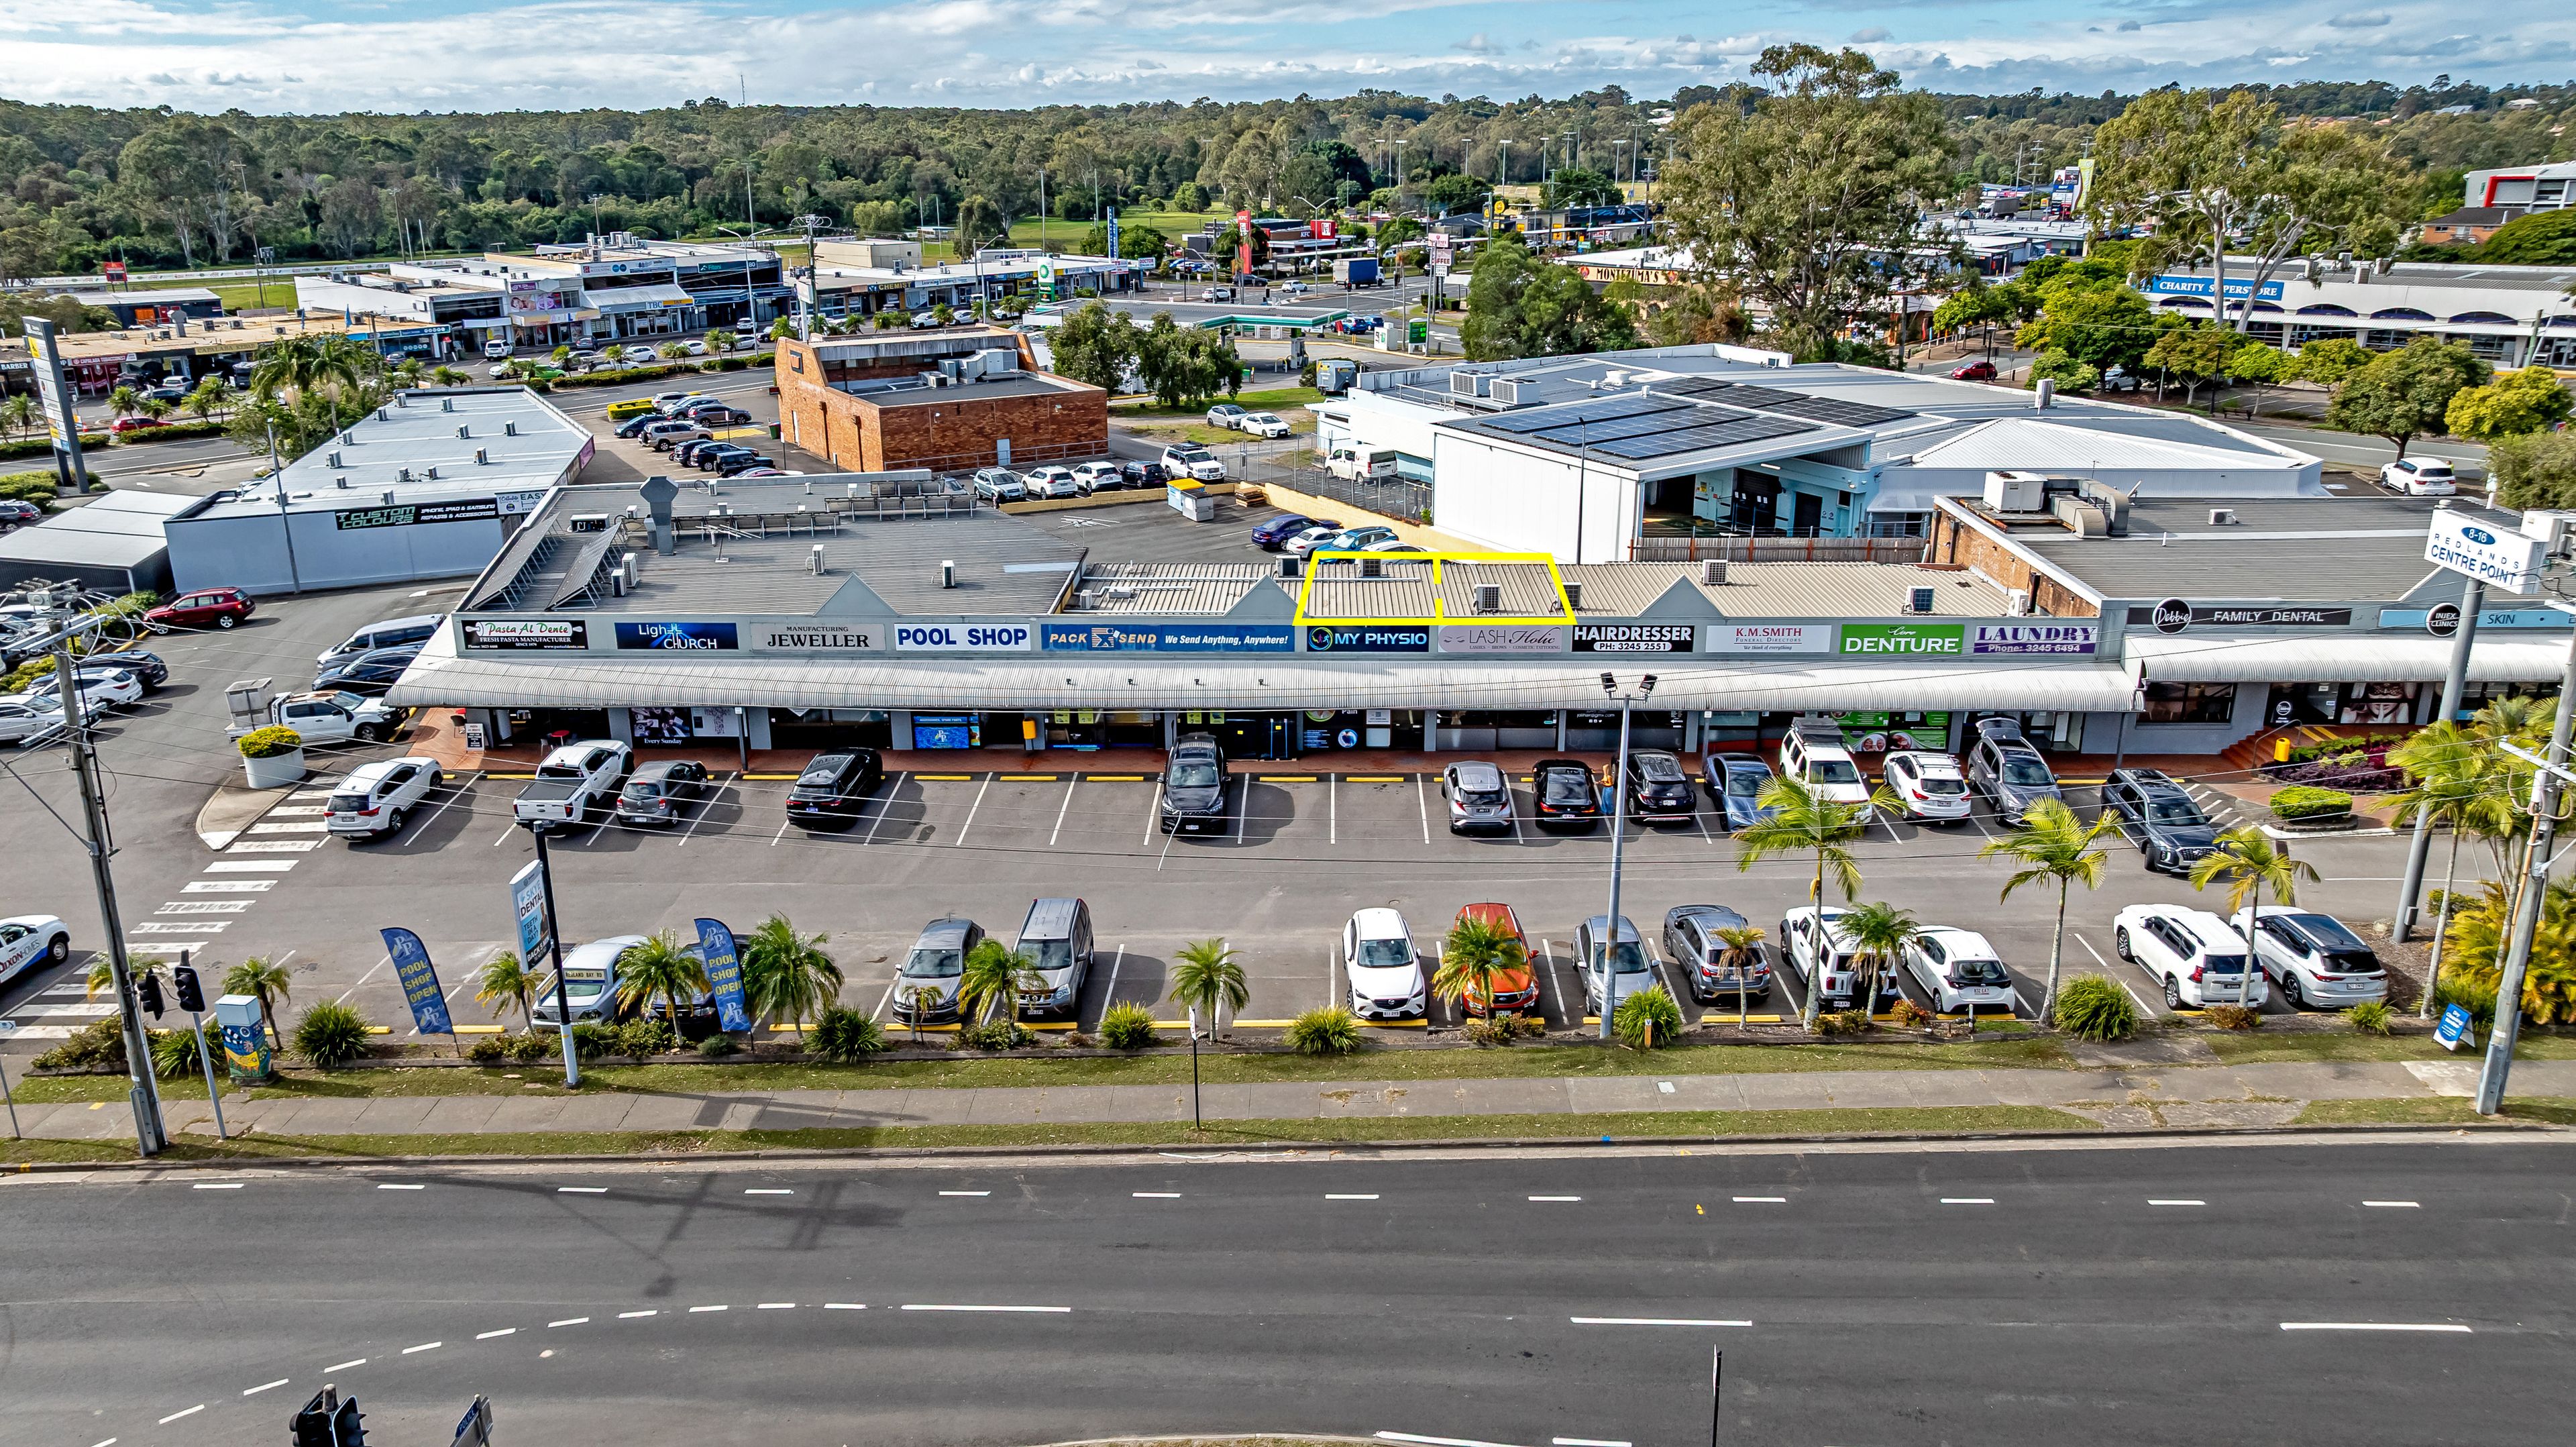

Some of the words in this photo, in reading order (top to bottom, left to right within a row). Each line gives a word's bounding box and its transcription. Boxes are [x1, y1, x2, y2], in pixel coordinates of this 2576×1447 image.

[878, 282, 912, 290] CHEMIST
[2159, 281, 2205, 292] CHARITY
[342, 513, 414, 529] COLOURS
[351, 506, 416, 521] CUSTOM
[2468, 528, 2487, 543] 8-16
[2434, 533, 2519, 570] REDLANDS
[2430, 544, 2476, 572] CENTRE
[2479, 561, 2518, 586] POINT
[2157, 606, 2192, 623] Debbie
[2214, 611, 2262, 622] FAMILY
[2271, 611, 2324, 622] DENTAL
[2435, 612, 2457, 620] INJEX
[2487, 614, 2515, 625] SKIN
[485, 622, 517, 635] Pasta
[519, 623, 534, 635] Al
[536, 622, 569, 633] Dente
[897, 627, 957, 645] POOL
[967, 627, 1027, 645] SHOP
[1469, 629, 1506, 644] LASH
[1508, 627, 1561, 645] Holic
[1574, 627, 1692, 641] HAIRDRESSER
[1735, 627, 1802, 637] K.M.SMITH
[1977, 627, 2097, 641] LAUNDRY
[767, 634, 870, 648] JEWELLER
[1049, 633, 1088, 643] PACK
[1118, 633, 1157, 643] SEND
[1165, 635, 1178, 643] We
[1179, 635, 1201, 644] Send
[1201, 635, 1242, 645] Anything,
[1243, 635, 1288, 645] Anywhere!
[1334, 633, 1360, 645] MY
[1365, 633, 1427, 645] PHYSIO
[1844, 637, 1960, 653] DENTURE
[1599, 643, 1615, 651] PH:
[1618, 643, 1641, 651] 3245
[1643, 643, 1666, 651] 2551
[1988, 644, 2023, 653] Phone:
[2025, 644, 2052, 652] 3245
[2054, 644, 2080, 652] 6494
[525, 879, 541, 900] SKYE
[521, 890, 543, 917] DENTAL
[523, 914, 538, 931] TEETH
[527, 930, 539, 944] DAY?
[527, 946, 540, 962] BACK
[539, 943, 543, 951] 5
[400, 960, 428, 977] POOL
[708, 954, 735, 968] POOL
[404, 972, 432, 990] SHOP
[711, 967, 738, 982] SHOP
[409, 985, 437, 1003] OPEN
[715, 981, 741, 996] OPEN
[459, 1407, 475, 1433] POLICE
